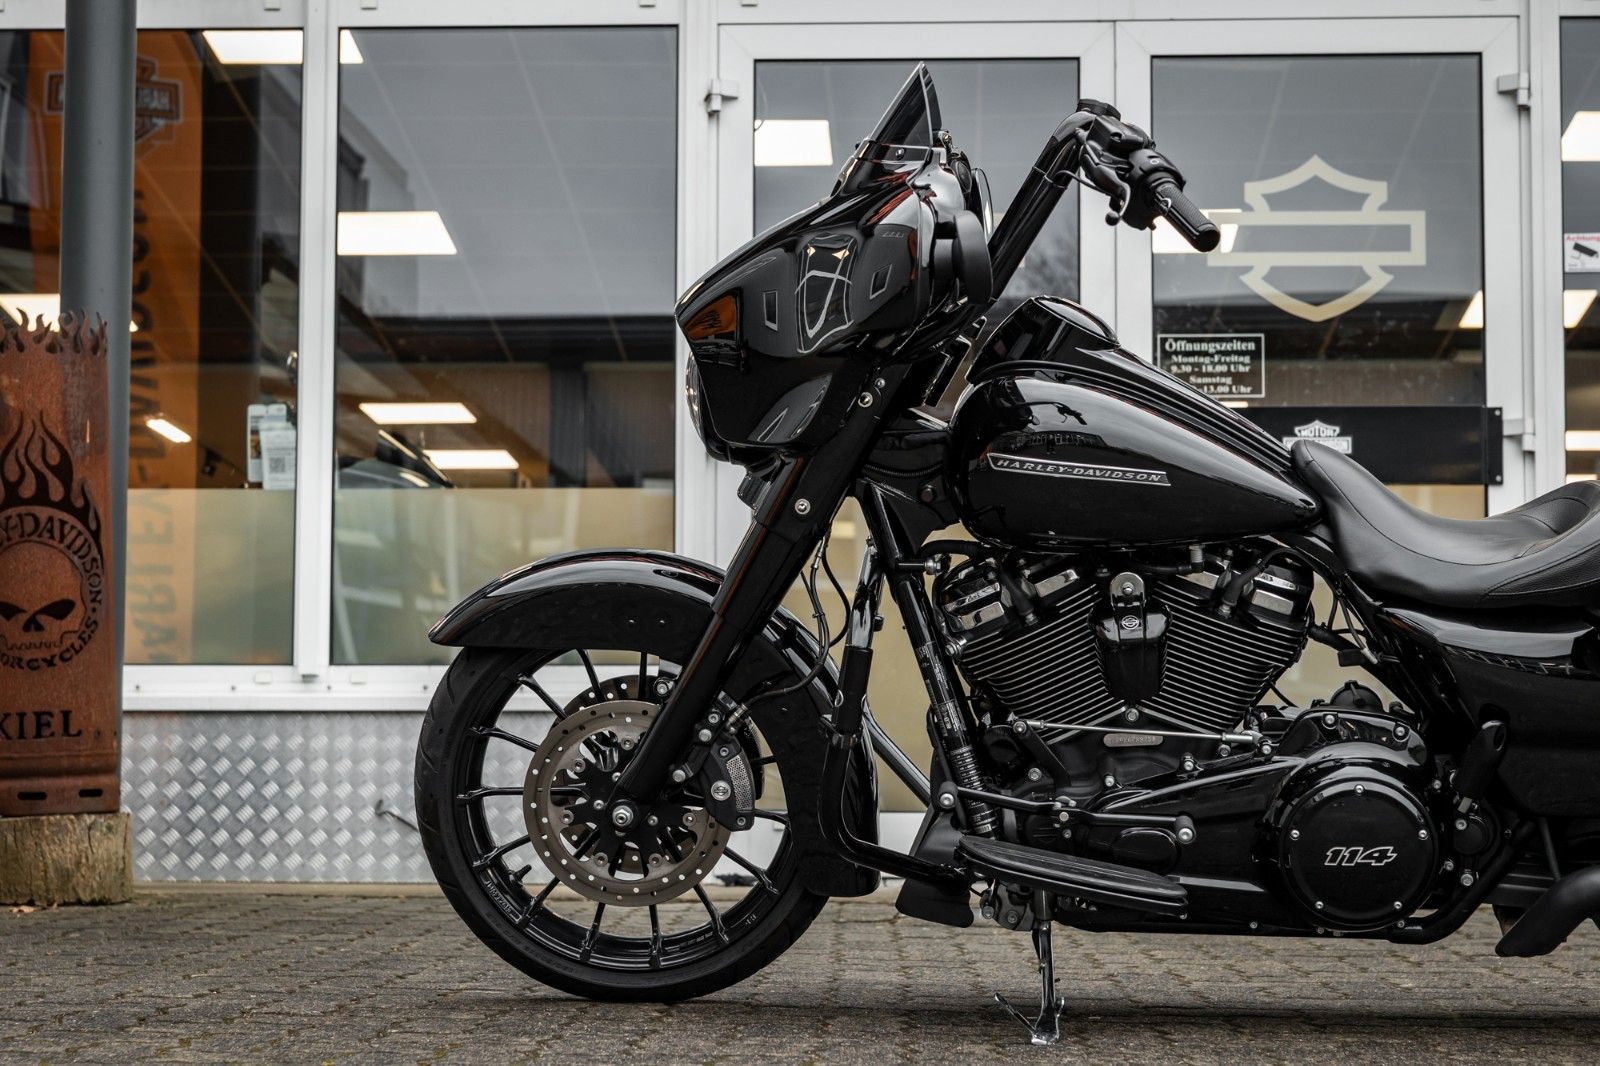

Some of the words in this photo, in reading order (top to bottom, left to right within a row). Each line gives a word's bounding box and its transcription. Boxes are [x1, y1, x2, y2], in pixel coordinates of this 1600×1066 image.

[1165, 339, 1255, 353] Öffnungszeiten
[1171, 354, 1251, 364] Montag-Freitag
[1230, 363, 1251, 373] Uhr
[1189, 375, 1232, 385] Samstag
[1231, 384, 1252, 394] Uhr
[1301, 426, 1334, 438] MOTOR
[997, 459, 1161, 483] HARLEY-DAVIDSON
[0, 512, 102, 605] Y-DAVIDSON
[0, 710, 82, 740] KIEL
[1324, 846, 1398, 866] 114
